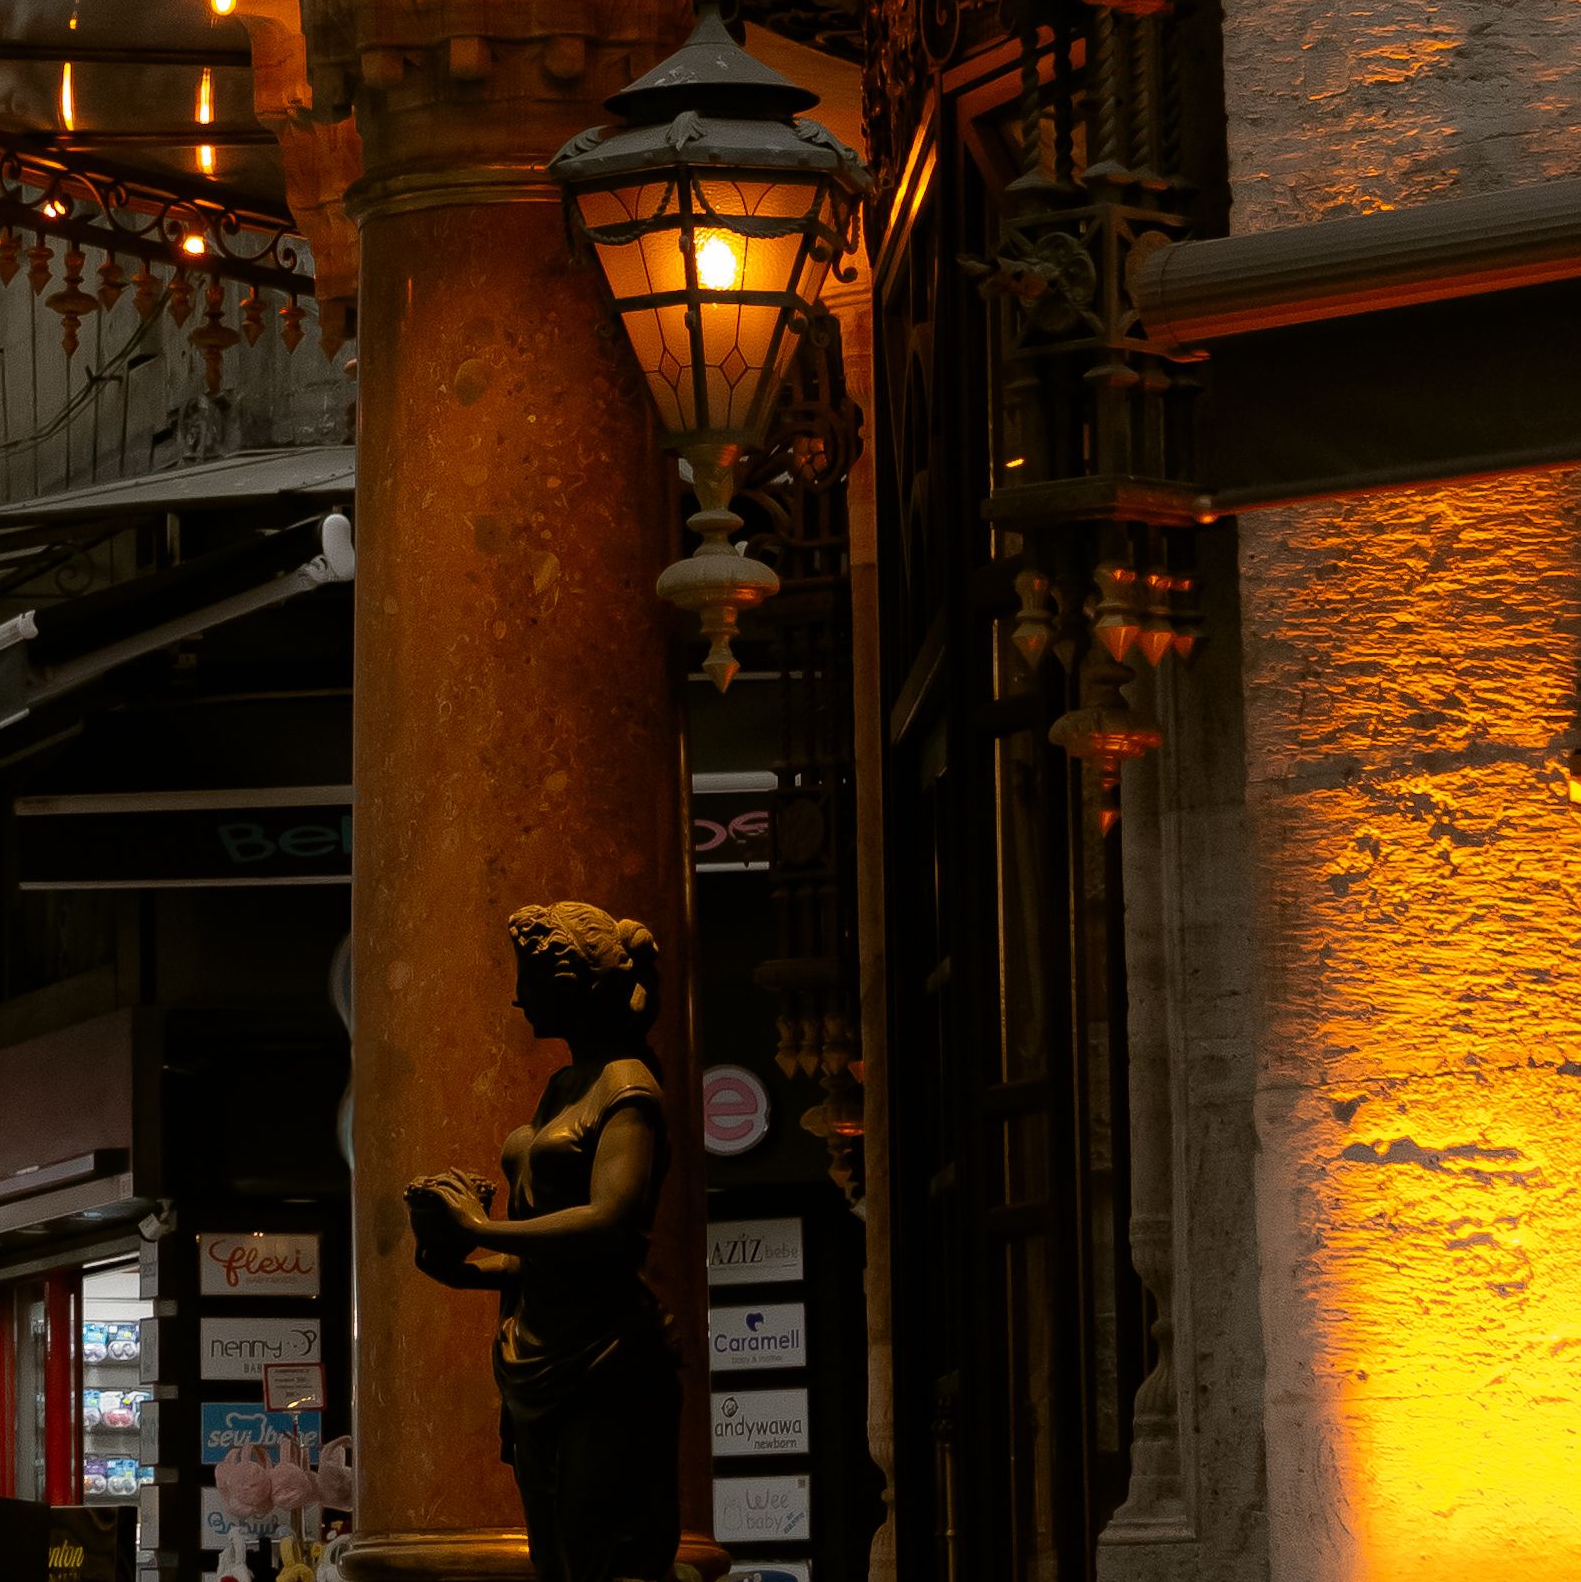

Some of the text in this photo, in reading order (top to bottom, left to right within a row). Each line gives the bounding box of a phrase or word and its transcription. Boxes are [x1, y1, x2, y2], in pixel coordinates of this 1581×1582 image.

[209, 1239, 314, 1287] flexi
[211, 1339, 282, 1359] nenny
[714, 1329, 800, 1353] Caramell
[714, 1416, 803, 1442] andywawa
[754, 1437, 797, 1450] newborn
